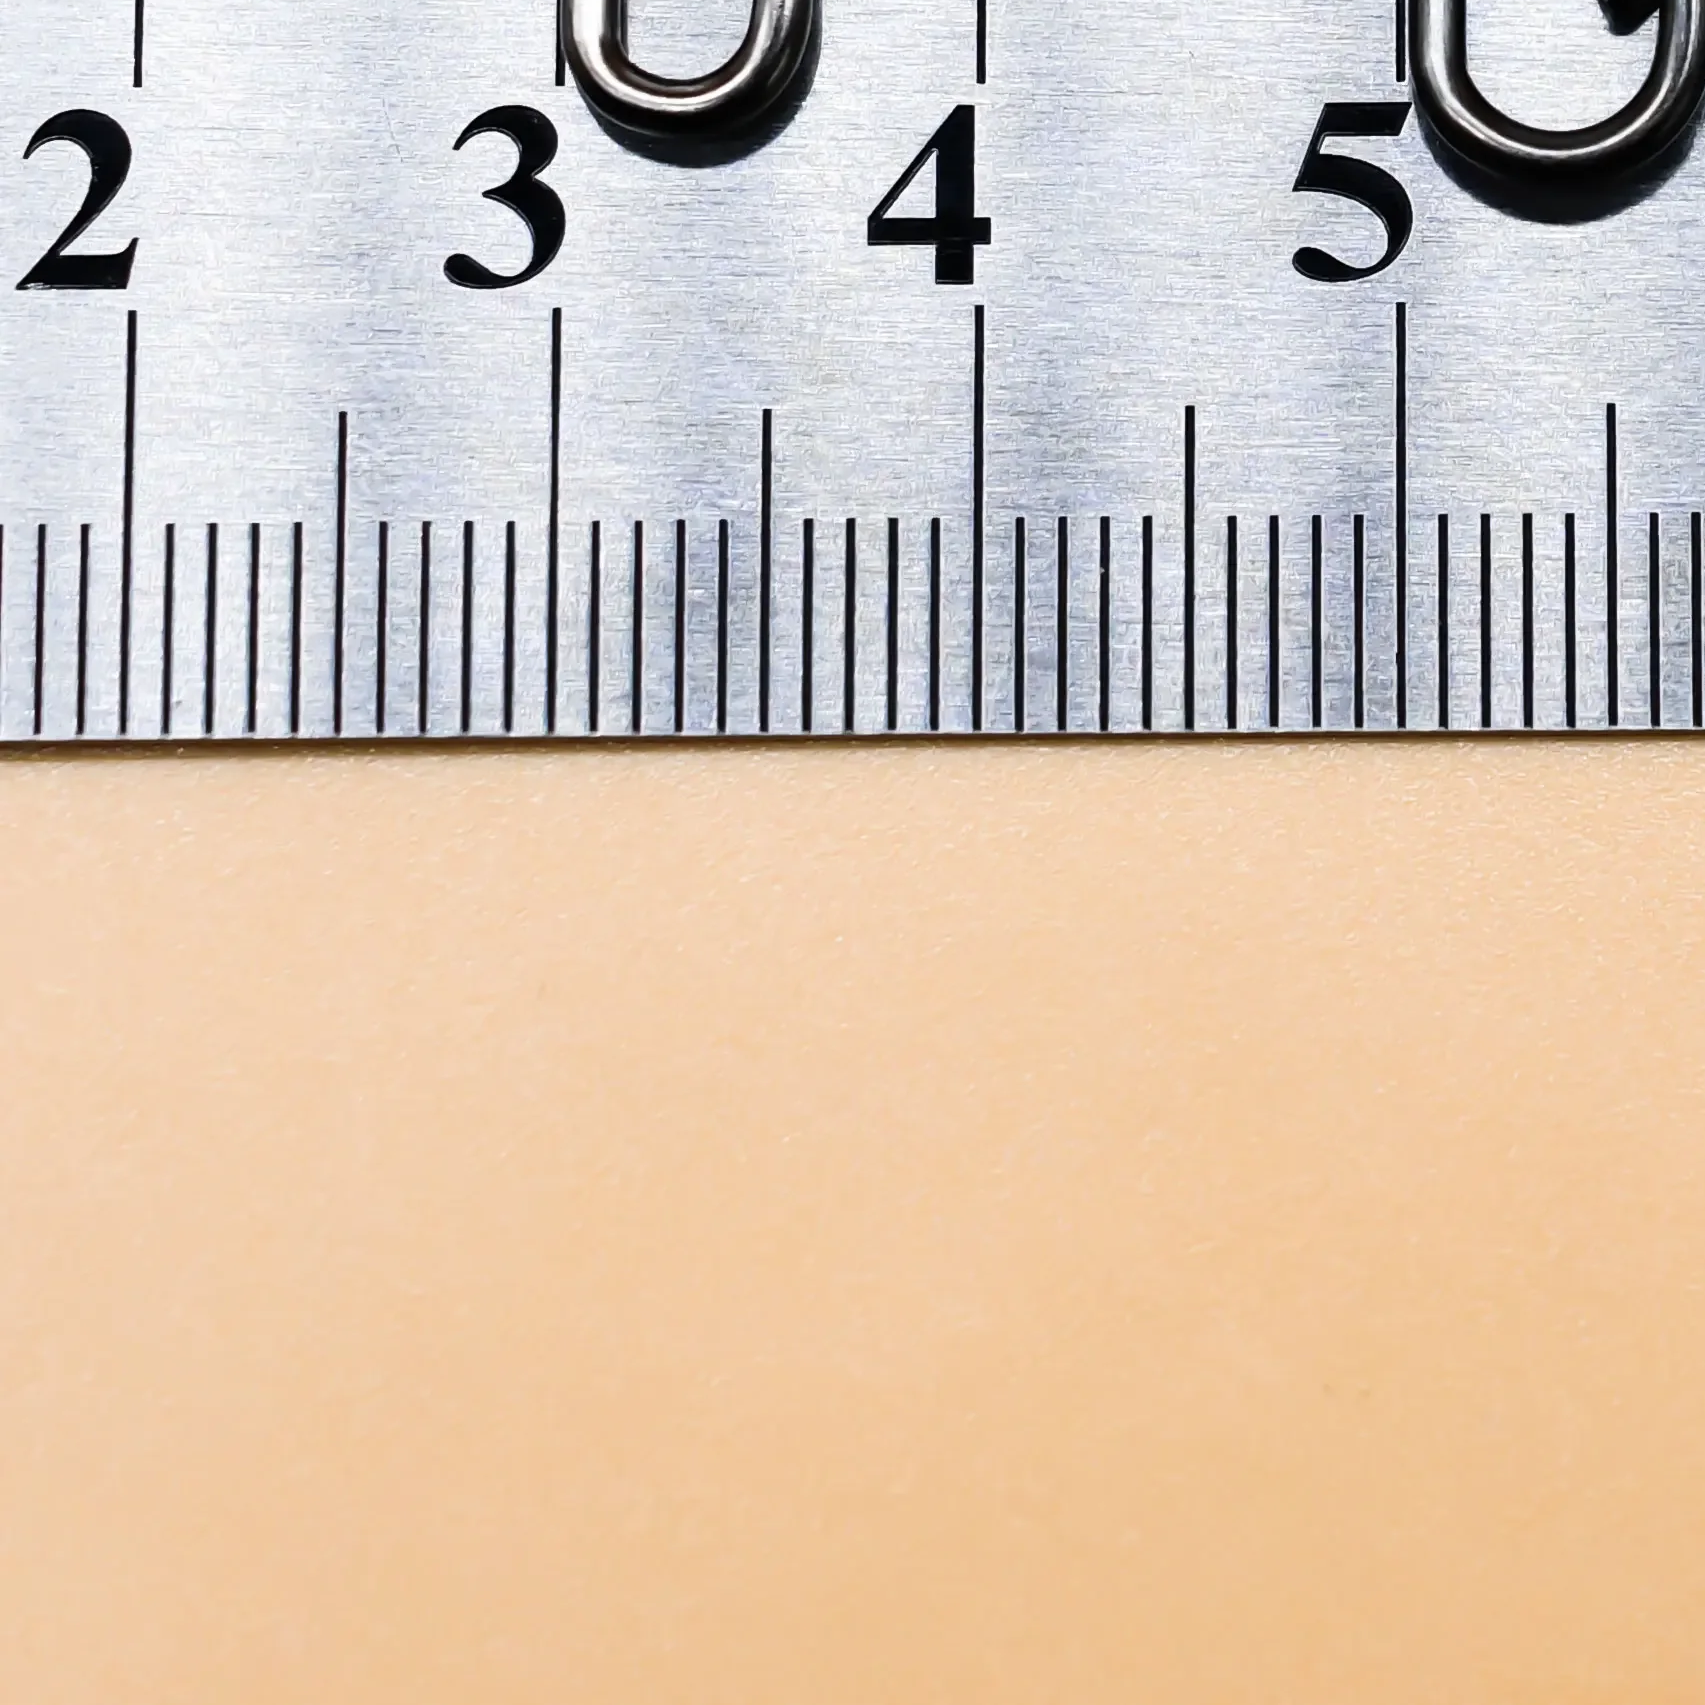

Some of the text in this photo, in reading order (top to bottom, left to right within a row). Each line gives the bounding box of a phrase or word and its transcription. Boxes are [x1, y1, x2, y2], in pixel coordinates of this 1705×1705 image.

[16, 109, 138, 290] 2
[444, 105, 567, 289] 3
[868, 105, 991, 285] 4
[1292, 102, 1412, 282] 5
